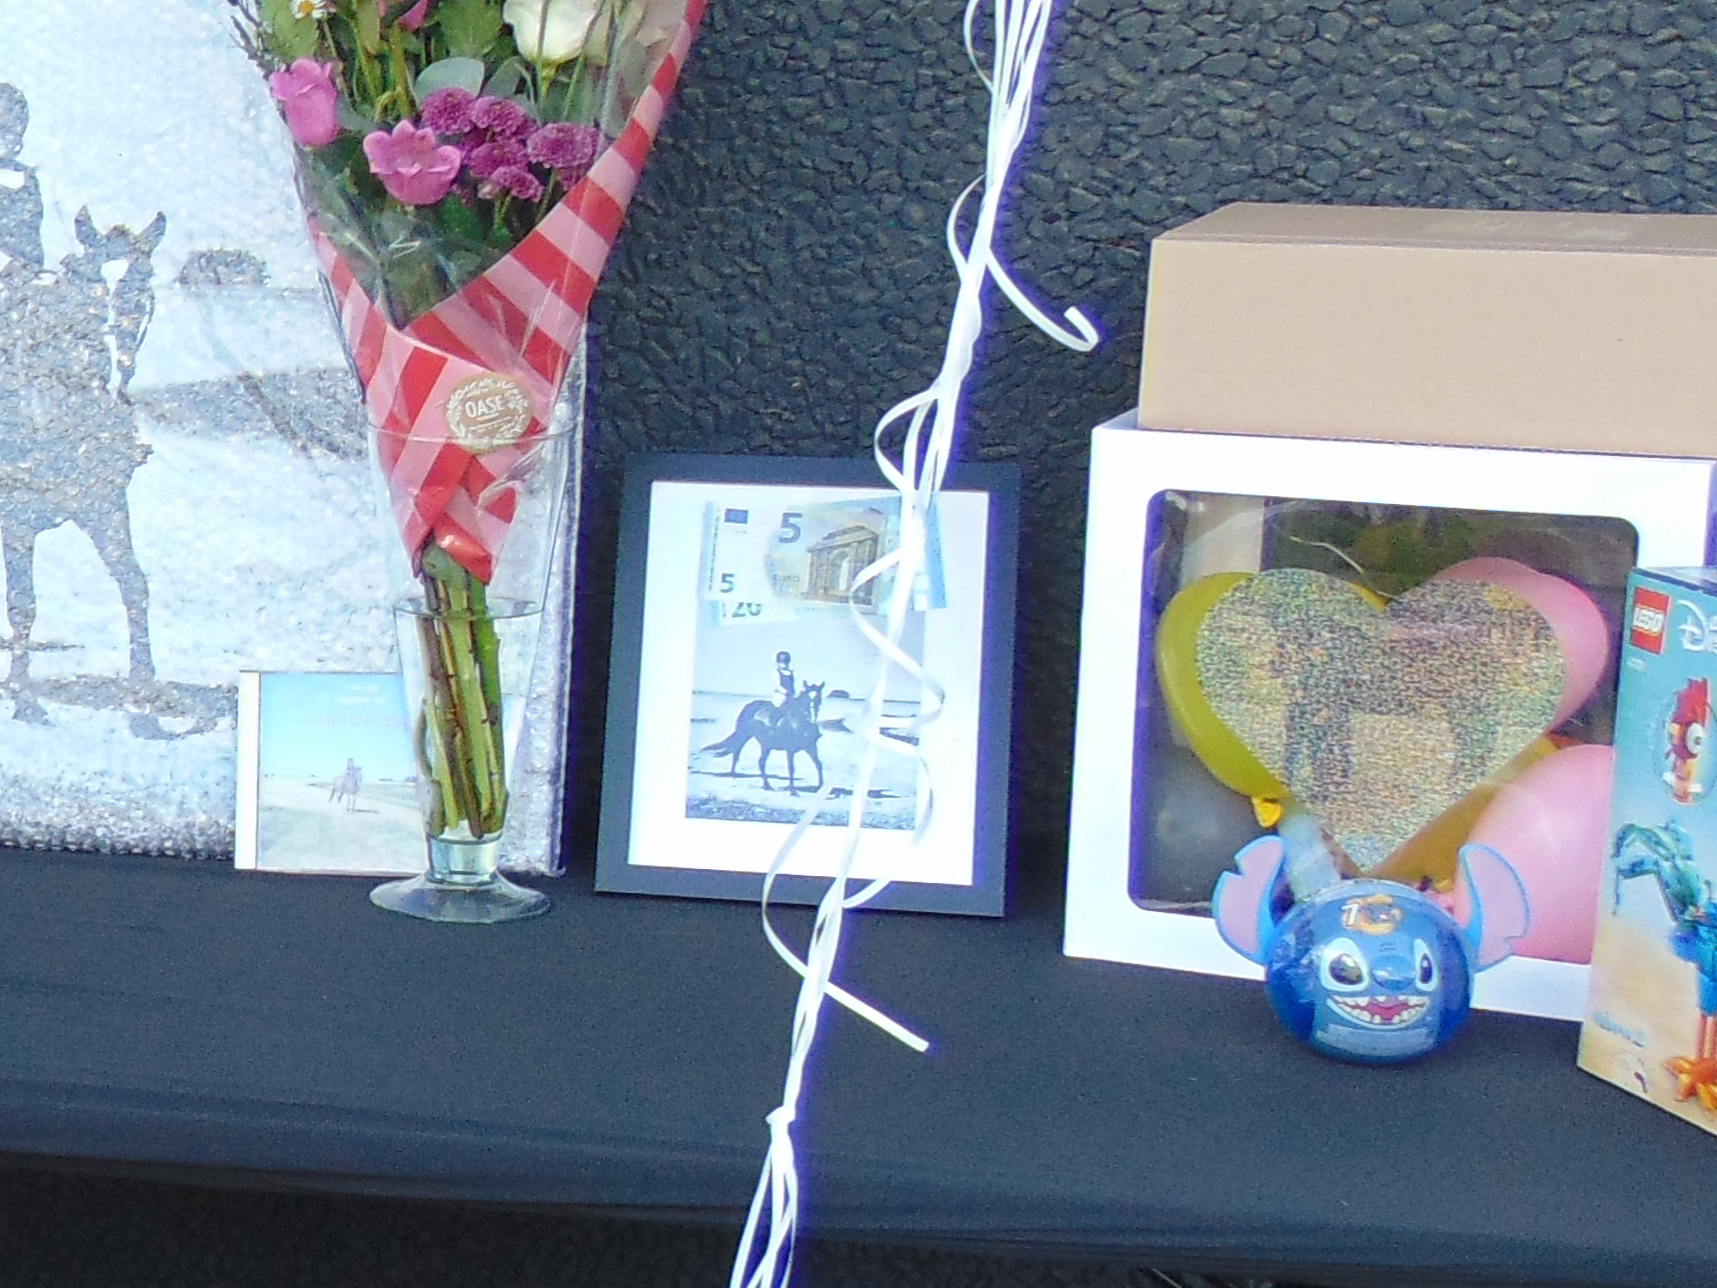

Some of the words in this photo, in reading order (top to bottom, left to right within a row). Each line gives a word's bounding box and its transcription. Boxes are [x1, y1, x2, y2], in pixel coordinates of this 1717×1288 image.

[465, 395, 505, 418] OASE
[778, 512, 804, 544] 5
[719, 573, 735, 593] 5
